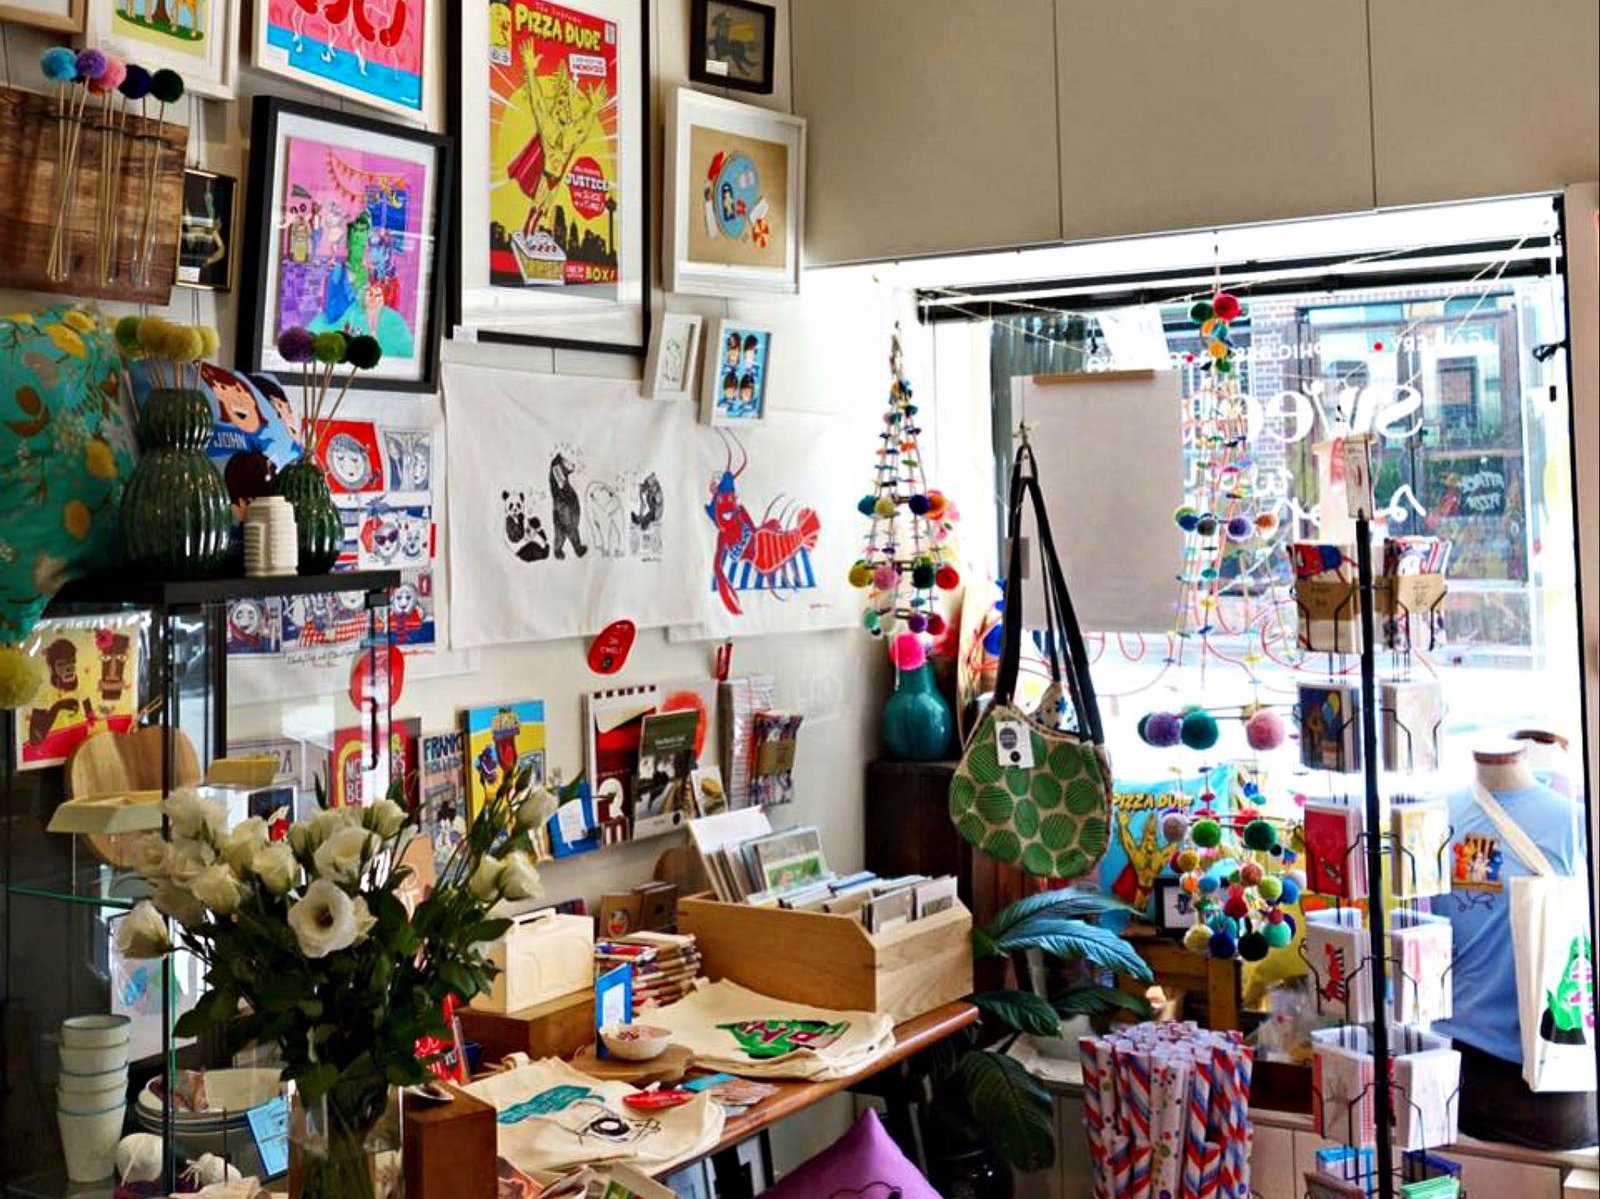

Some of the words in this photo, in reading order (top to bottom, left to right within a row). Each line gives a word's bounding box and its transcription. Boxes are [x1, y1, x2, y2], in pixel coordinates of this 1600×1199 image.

[514, 3, 563, 41] PIZZA
[564, 22, 601, 50] DUDE
[213, 431, 247, 451] JOHN
[1111, 793, 1155, 810] PIZZA
